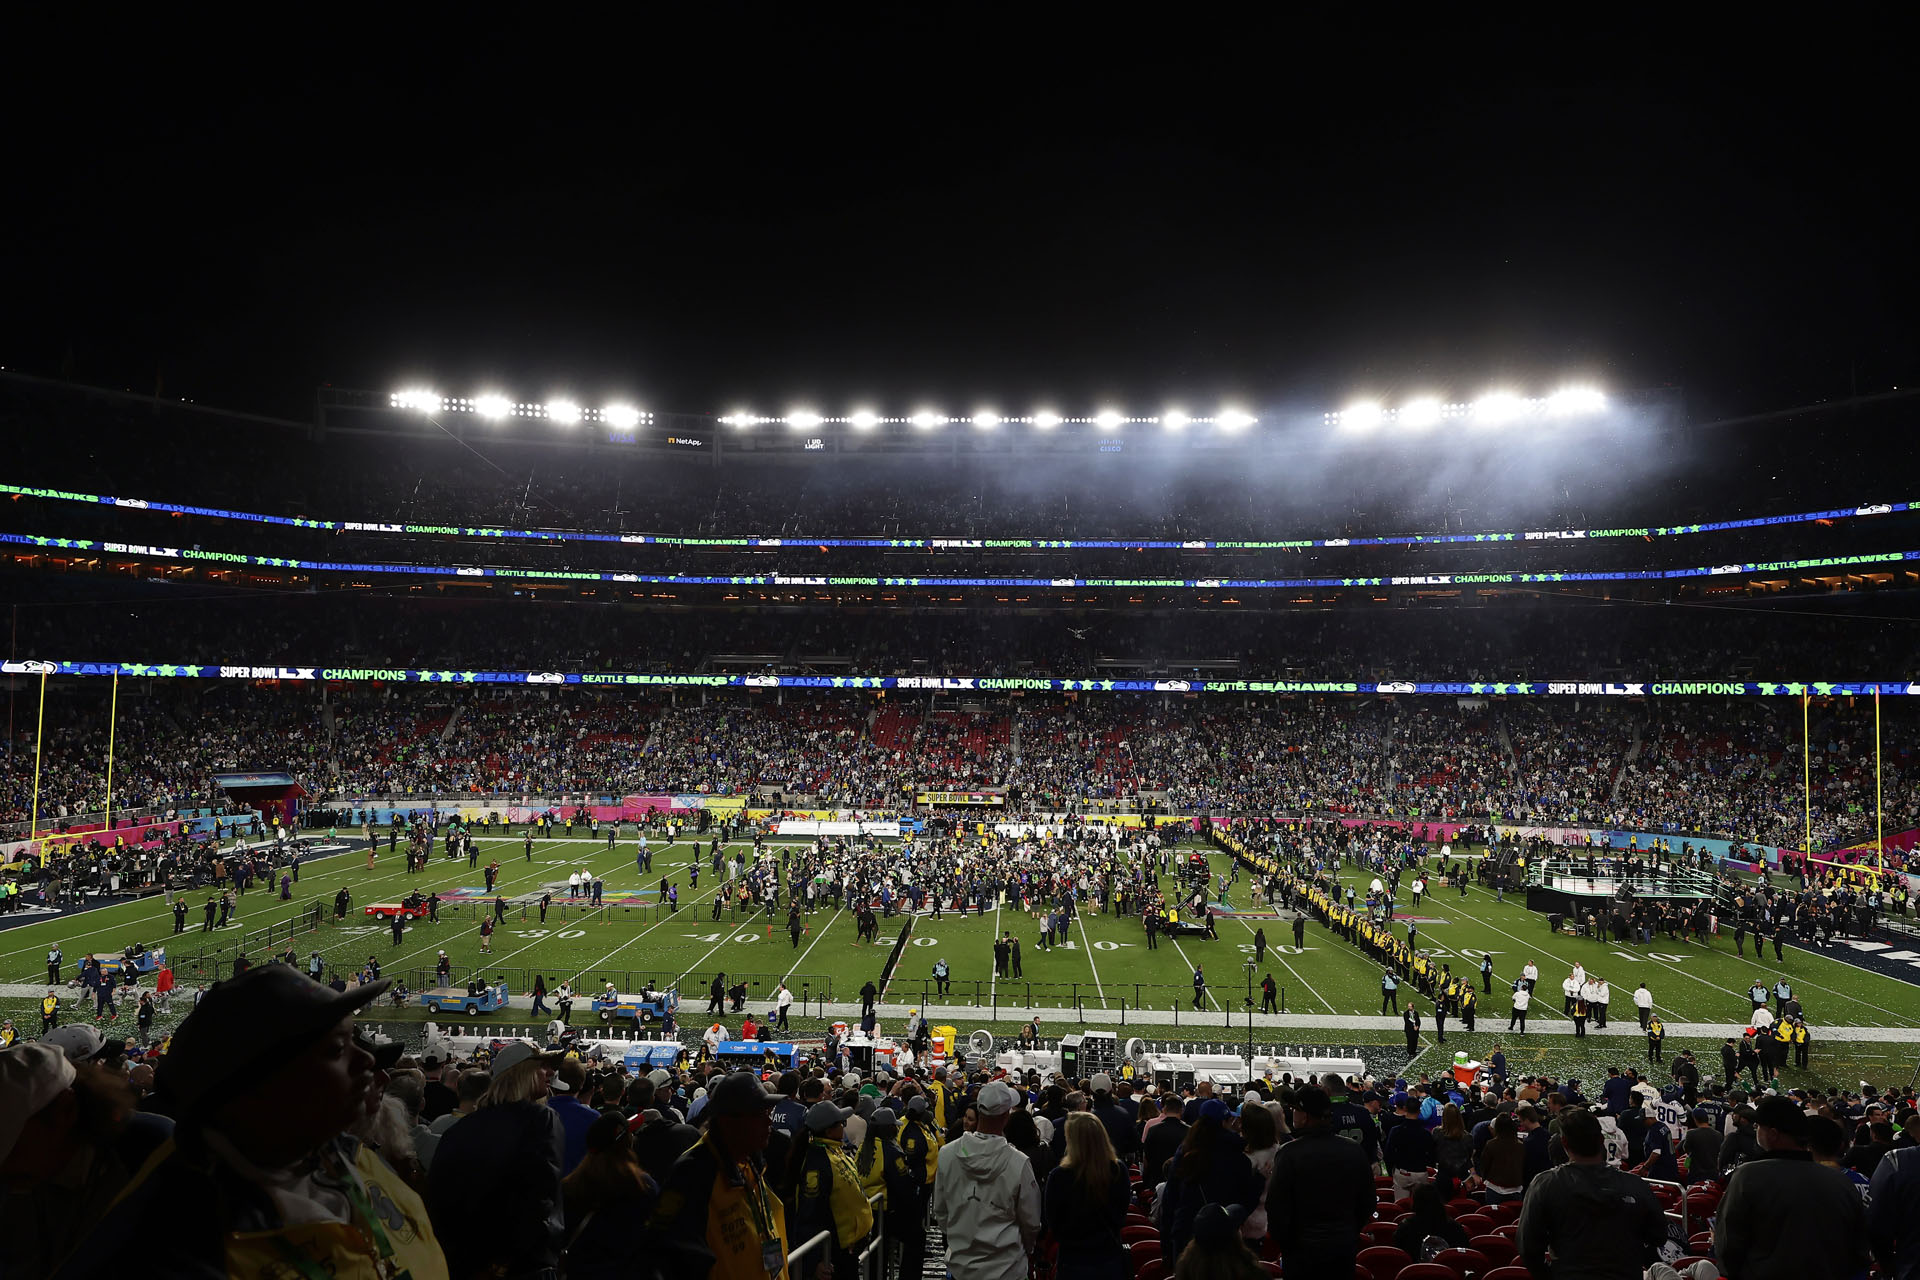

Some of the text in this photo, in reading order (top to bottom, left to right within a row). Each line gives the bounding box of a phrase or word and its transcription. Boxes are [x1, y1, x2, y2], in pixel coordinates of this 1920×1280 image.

[609, 433, 636, 444] VISA
[230, 512, 263, 522] SEATTLE
[1767, 514, 1803, 524] SEATTLE
[344, 522, 458, 534] SUPER BOWL LX CHAMPIONS
[1525, 532, 1543, 540] SUPER
[1561, 530, 1586, 539] LX
[962, 540, 982, 548] LX
[104, 542, 247, 562] SUPER BOWL LX CHAMPIONS
[1757, 562, 1794, 570] SEATTLE
[1797, 553, 1903, 567] SEAHAWKS
[384, 564, 415, 573] SEATTLE
[1391, 577, 1410, 585] SUPER
[1427, 576, 1451, 584] LX
[1628, 571, 1662, 579] SEATTLE
[806, 577, 826, 585] LX
[220, 667, 406, 680] SUPER BOWL LX CHAMPIONS
[625, 676, 728, 686] SEAHAWKS
[897, 677, 1051, 688] SUPER BOWL LX CHAMPIONS
[1208, 681, 1247, 691] SEATTLE
[1249, 682, 1356, 692] SEAHAWKS
[1548, 683, 1745, 694] SUPER BOWL LX CHAMPIONS
[928, 793, 948, 802] SUPER
[949, 793, 967, 802] BOWL
[518, 929, 586, 939] 30
[695, 932, 760, 943] 40
[876, 937, 938, 947] 50
[1237, 943, 1304, 955] 30
[1420, 948, 1491, 958] 20
[1610, 952, 1683, 963] 10
[772, 1113, 787, 1124] AYE
[1342, 1114, 1356, 1125] FAN
[1658, 1105, 1676, 1124] 80
